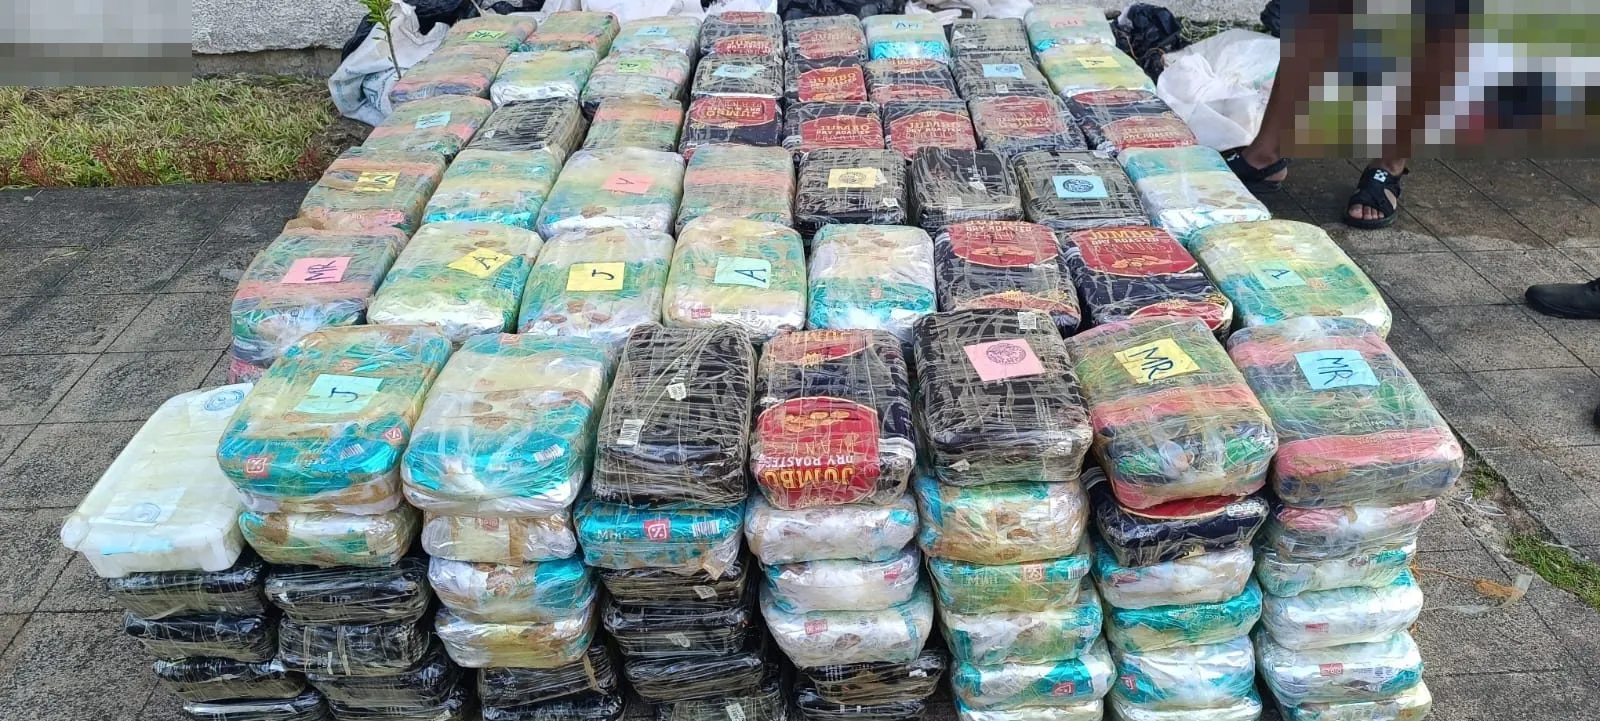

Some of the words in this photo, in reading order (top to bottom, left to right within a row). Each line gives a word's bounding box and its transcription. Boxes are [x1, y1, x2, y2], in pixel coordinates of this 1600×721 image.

[1088, 230, 1155, 239] JUMBO
[303, 260, 338, 281] MR
[591, 268, 615, 281] J
[733, 267, 768, 284] A
[1128, 346, 1175, 380] MR
[1316, 356, 1354, 386] MR
[328, 387, 360, 404] J
[827, 454, 854, 465] DRY
[764, 467, 854, 489] JUMBO
